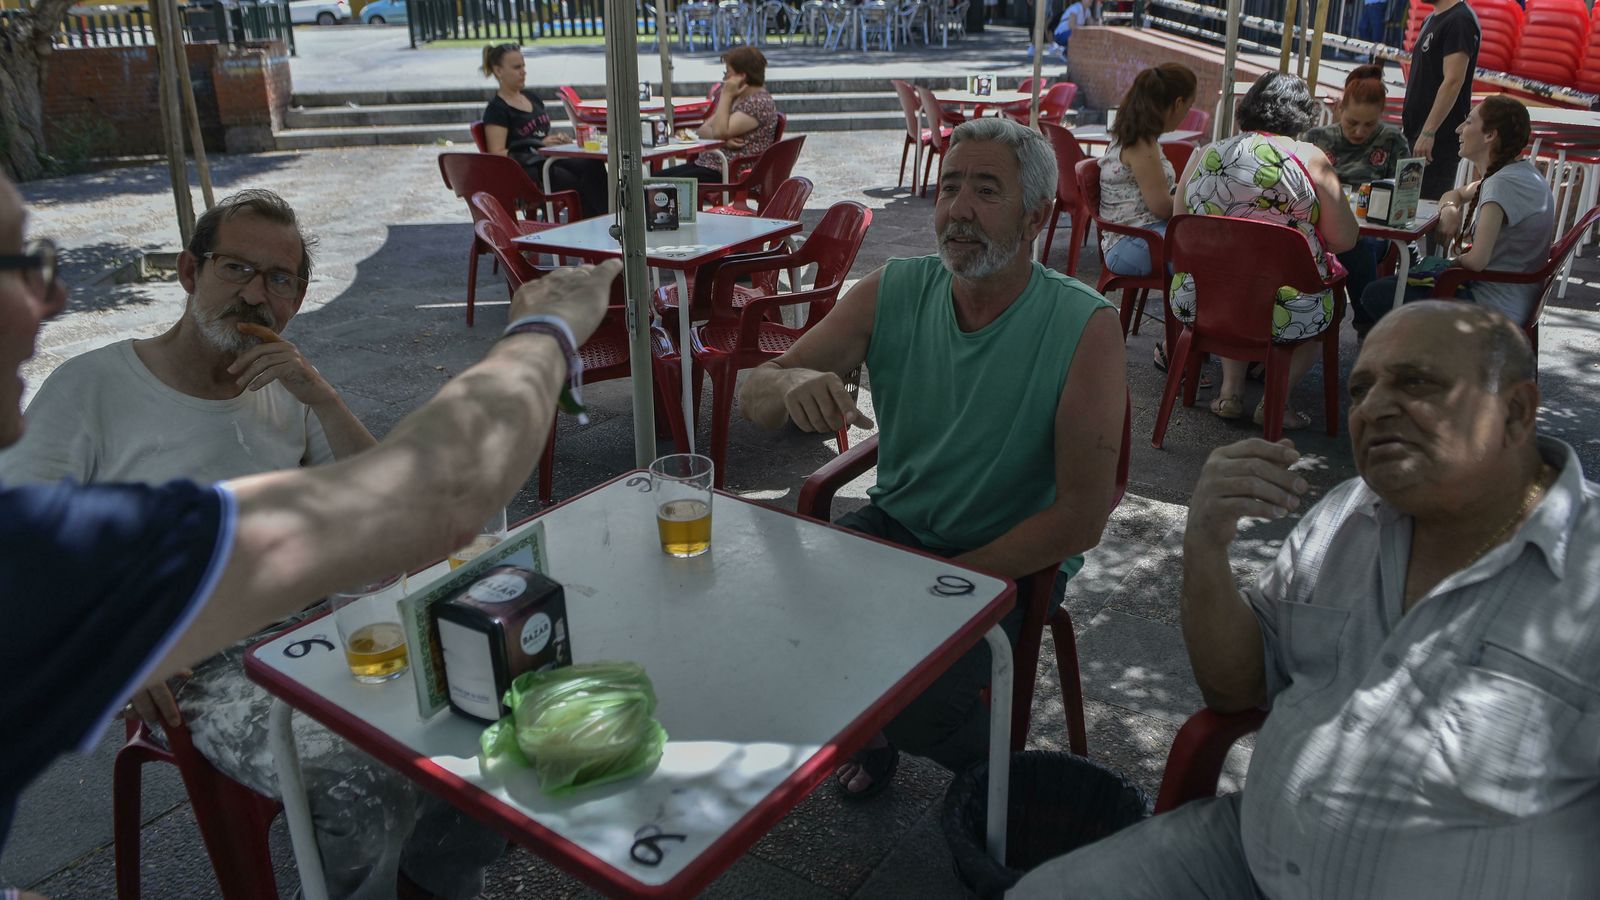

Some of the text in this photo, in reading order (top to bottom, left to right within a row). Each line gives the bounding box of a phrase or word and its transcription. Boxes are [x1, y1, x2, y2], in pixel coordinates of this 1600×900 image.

[477, 579, 518, 597] BAZAR
[522, 622, 549, 646] BAZAR
[282, 639, 335, 658] 6
[630, 834, 687, 867] 6
